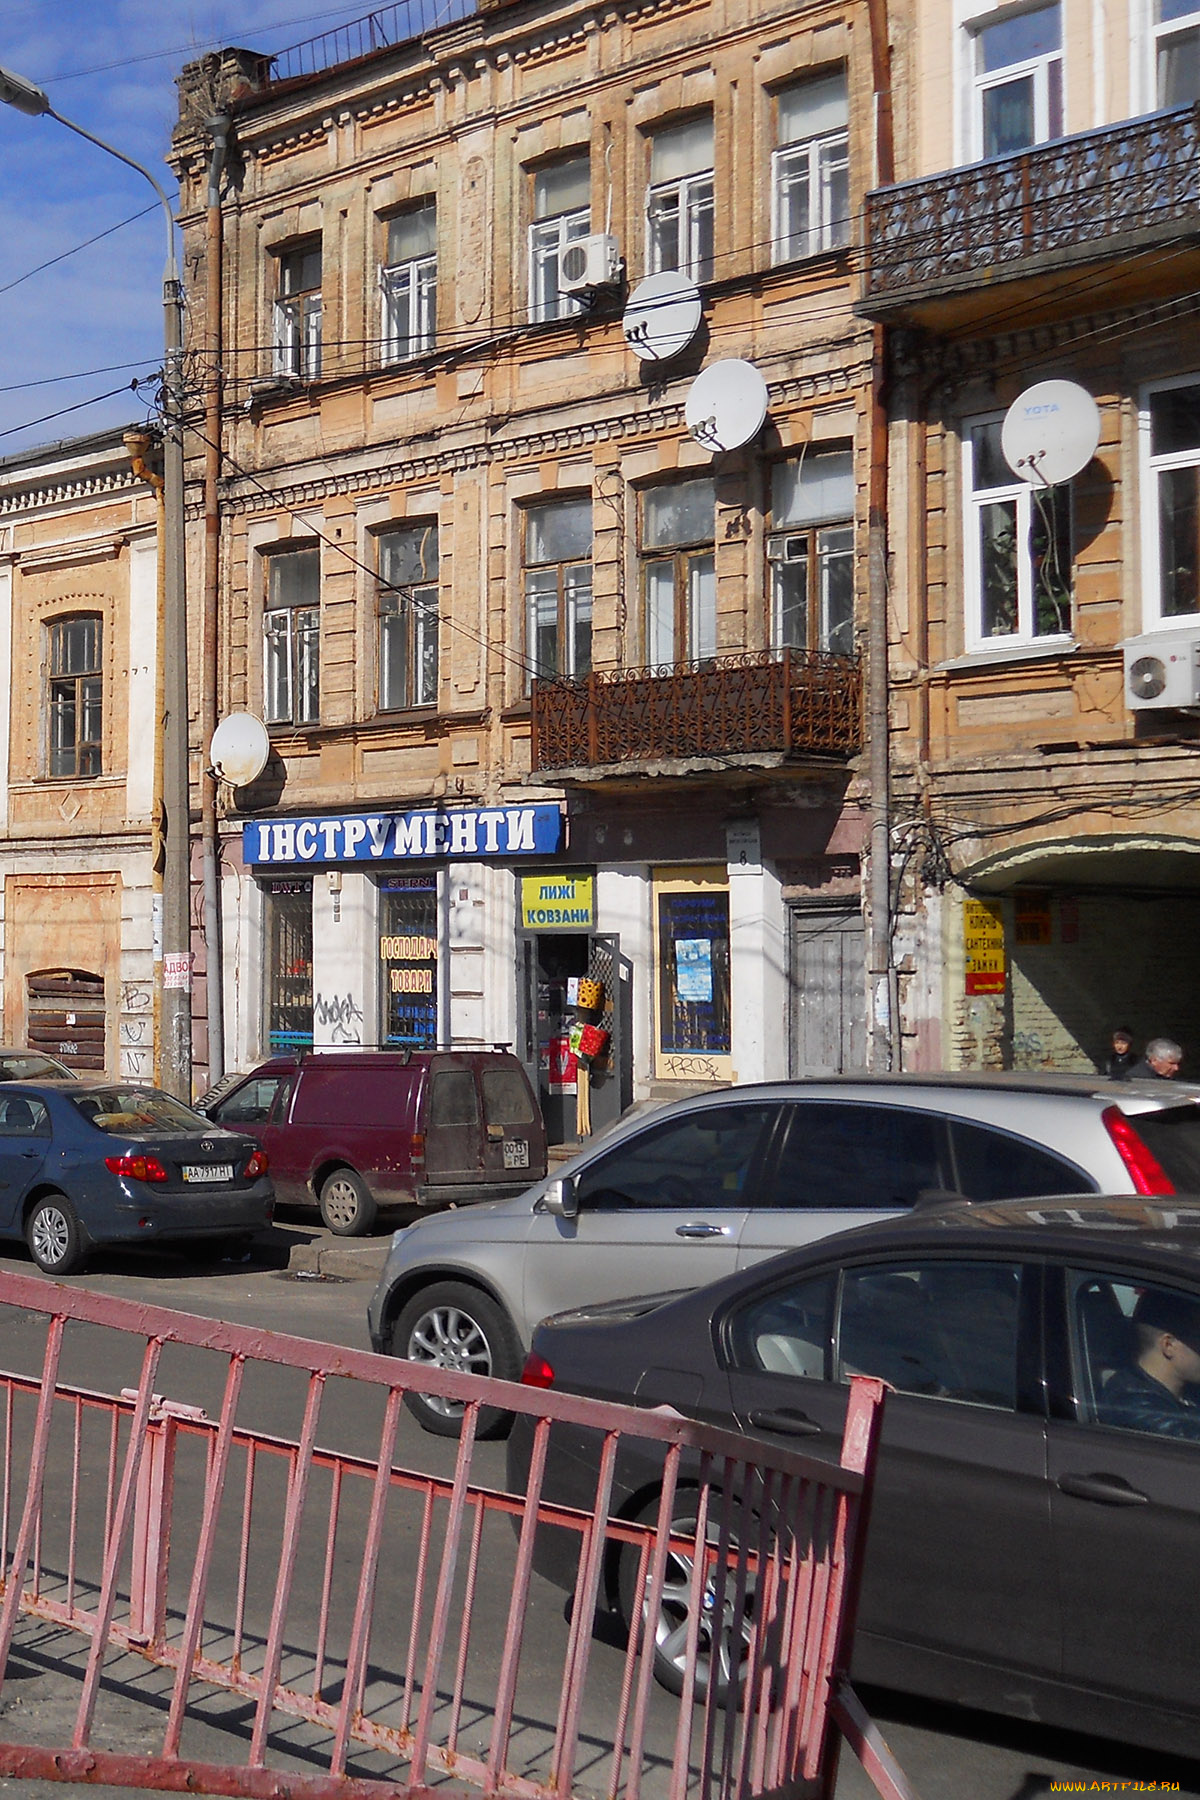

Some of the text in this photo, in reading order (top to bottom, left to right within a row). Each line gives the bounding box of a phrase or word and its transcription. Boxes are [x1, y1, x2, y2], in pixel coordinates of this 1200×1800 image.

[257, 809, 536, 860] ІНСТРУМЕНТИ
[538, 878, 576, 900] ЛИЖІ
[526, 908, 590, 924] КОВЗАНИ
[390, 969, 432, 994] ТОВАРИ
